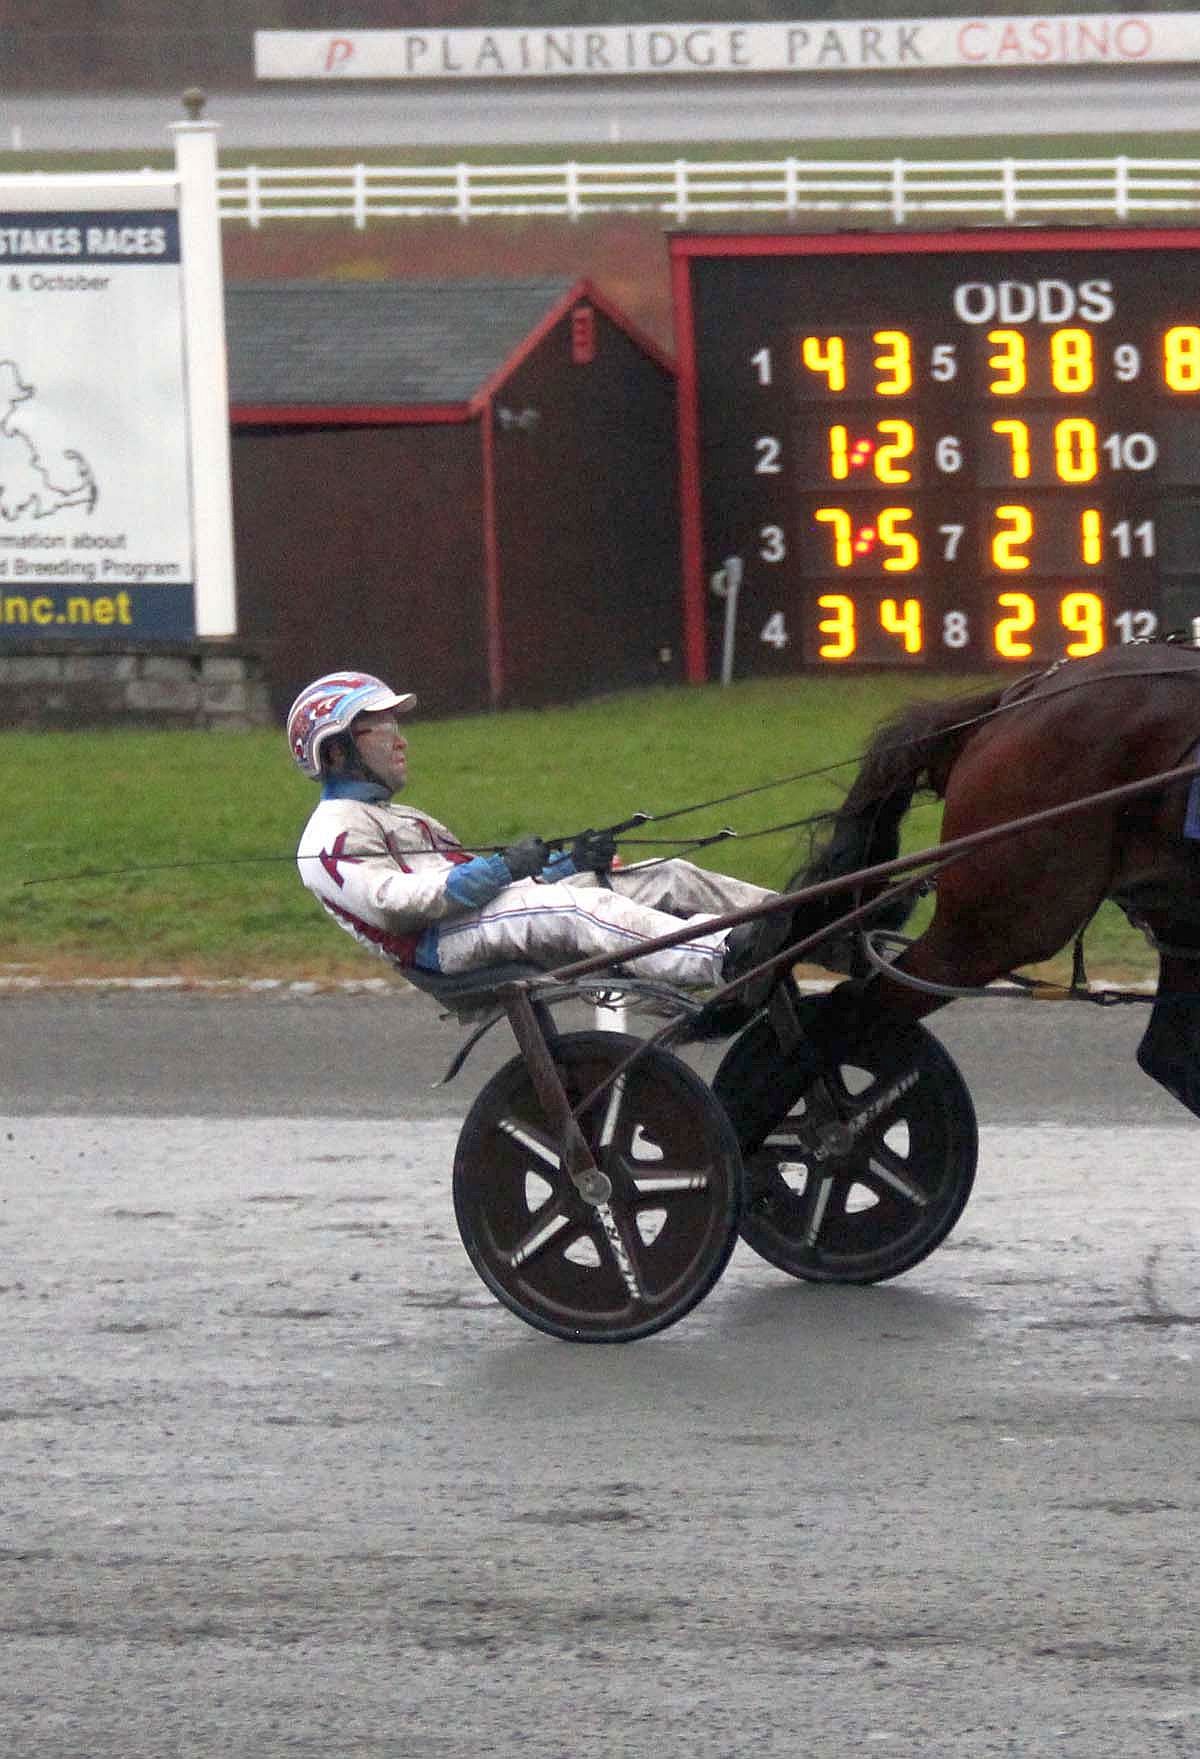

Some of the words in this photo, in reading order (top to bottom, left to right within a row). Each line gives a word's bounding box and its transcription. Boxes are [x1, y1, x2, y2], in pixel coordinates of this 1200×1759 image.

[404, 29, 752, 71] PLAINRIDGE
[787, 26, 925, 66] PARK
[956, 20, 1154, 61] CASINO
[86, 227, 166, 255] RACES
[29, 273, 110, 291] October
[954, 280, 1115, 324] ODDS
[751, 348, 772, 386] 1
[932, 345, 957, 382] 5
[1114, 344, 1140, 381] 9
[755, 437, 782, 474] 2
[935, 437, 962, 473] 6
[1103, 433, 1157, 471] 10
[760, 526, 786, 563] 3
[938, 524, 965, 561] 7
[1111, 521, 1155, 558] 11
[15, 558, 95, 580] Breeding
[103, 558, 180, 580] Program
[761, 612, 788, 649] 4
[943, 611, 969, 648] 8
[1115, 611, 1157, 644] 12
